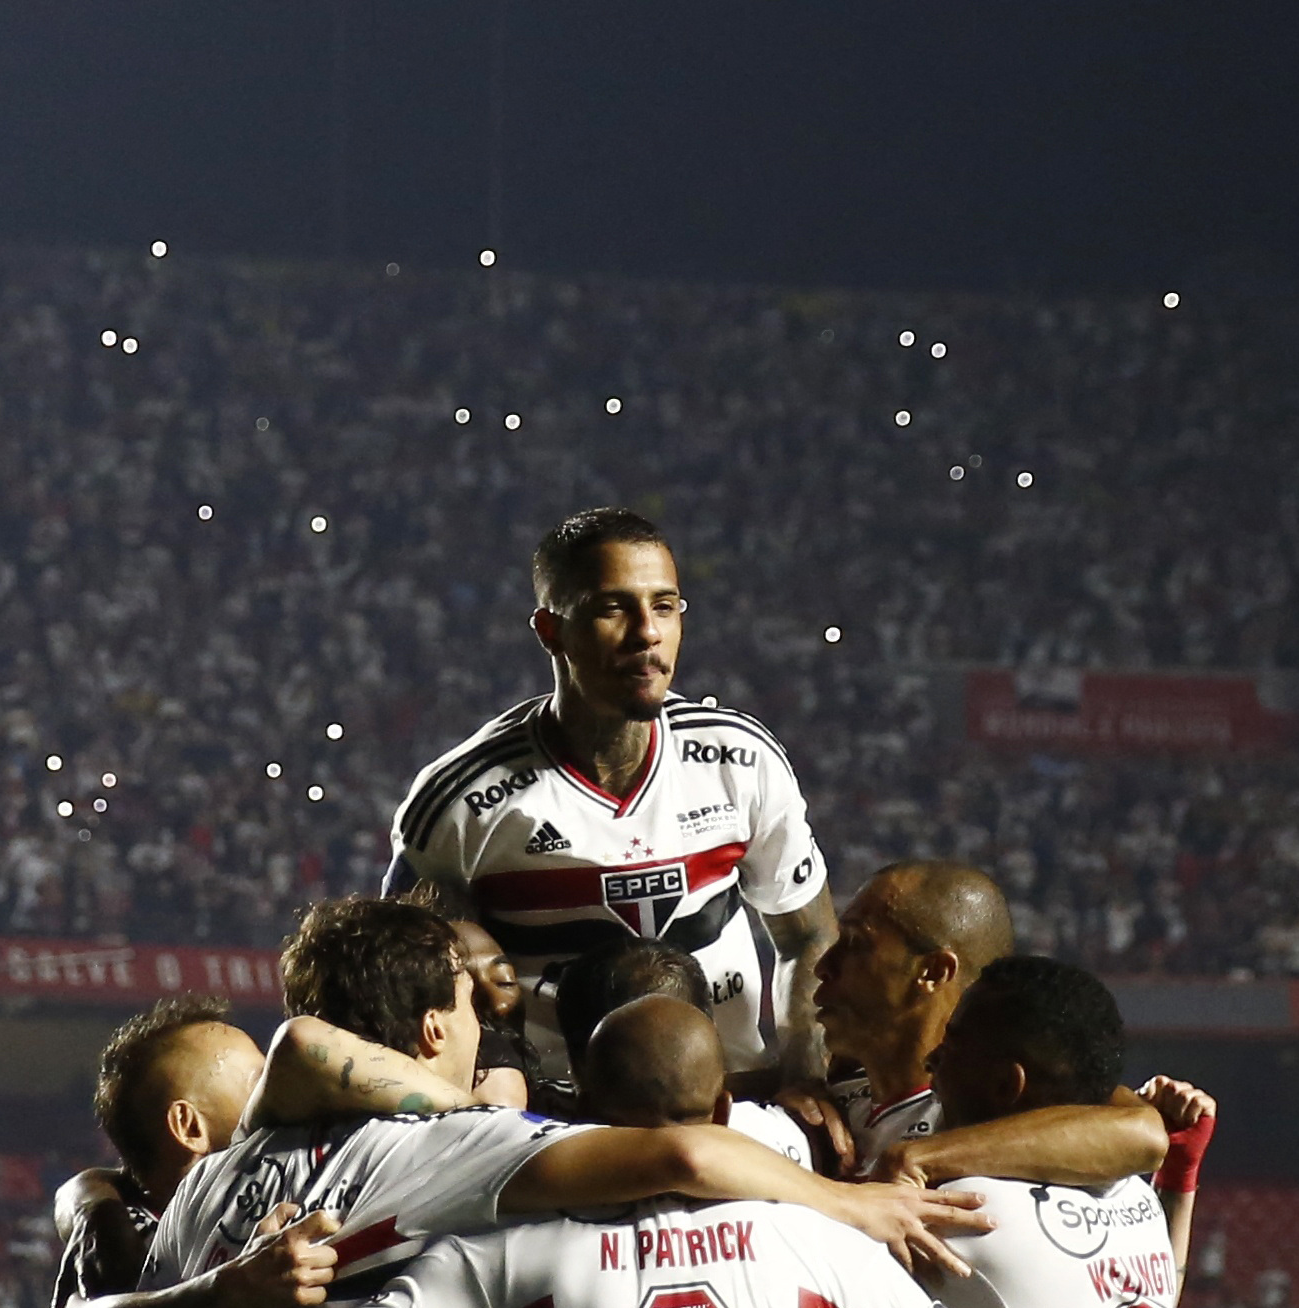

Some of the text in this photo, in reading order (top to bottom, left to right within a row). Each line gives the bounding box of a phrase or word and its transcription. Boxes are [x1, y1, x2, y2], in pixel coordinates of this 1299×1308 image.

[525, 839, 572, 854] adidas
[608, 871, 680, 897] SPFC
[601, 1220, 756, 1271] N. PATRICK
